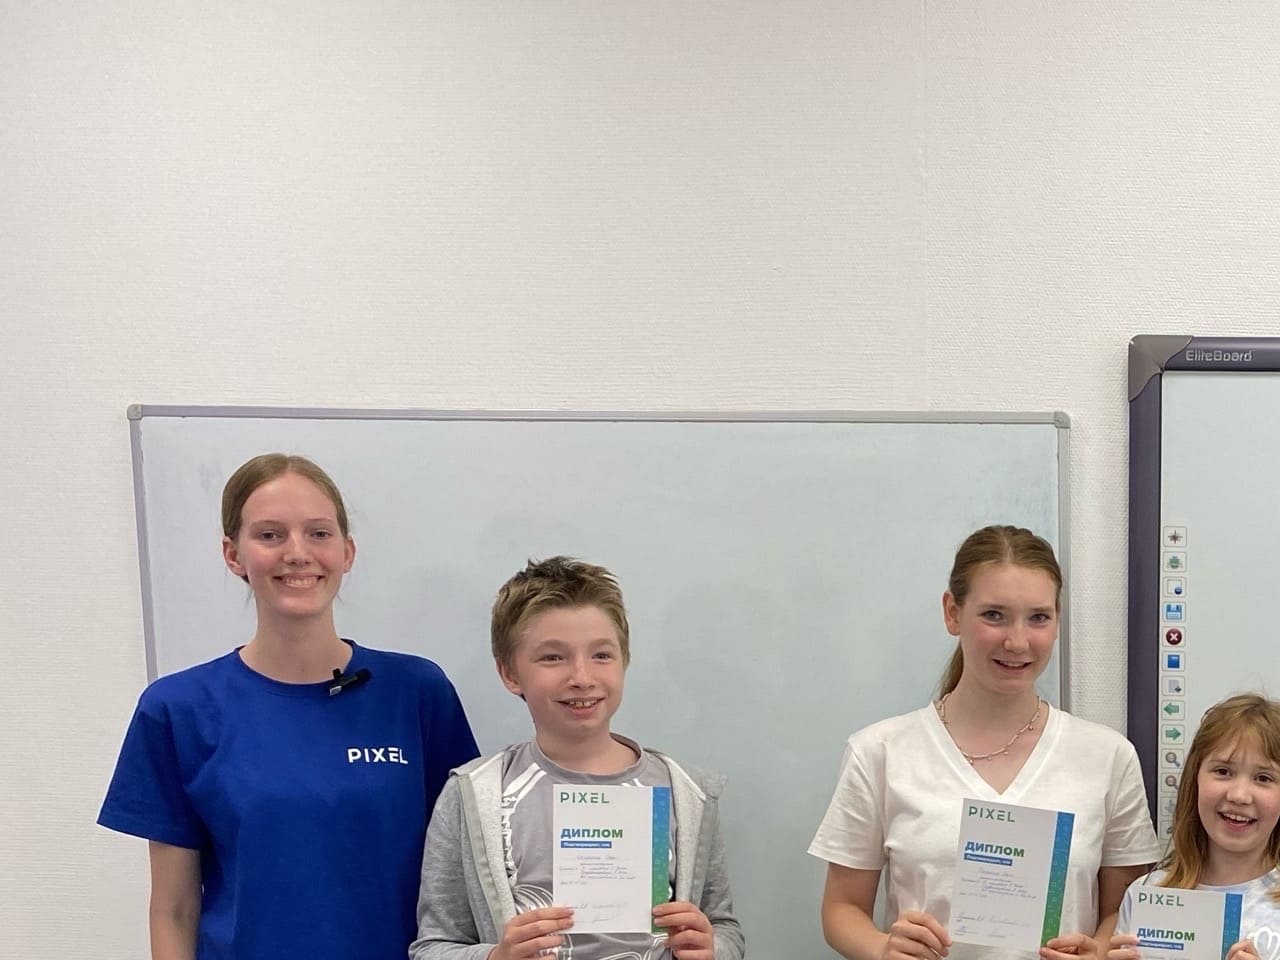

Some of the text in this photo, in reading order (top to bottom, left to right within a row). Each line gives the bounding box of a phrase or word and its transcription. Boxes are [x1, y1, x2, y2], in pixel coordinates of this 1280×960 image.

[1186, 350, 1252, 361] EliteBoard
[347, 747, 409, 765] PIXEL
[560, 792, 610, 804] PIXEL
[968, 806, 1016, 823] PIXEL
[560, 828, 624, 839] ДИПЛОМ
[964, 841, 1025, 857] ДИПЛОМ
[1138, 892, 1185, 907] PIXEL
[1136, 927, 1195, 941] ДИПЛОМ
